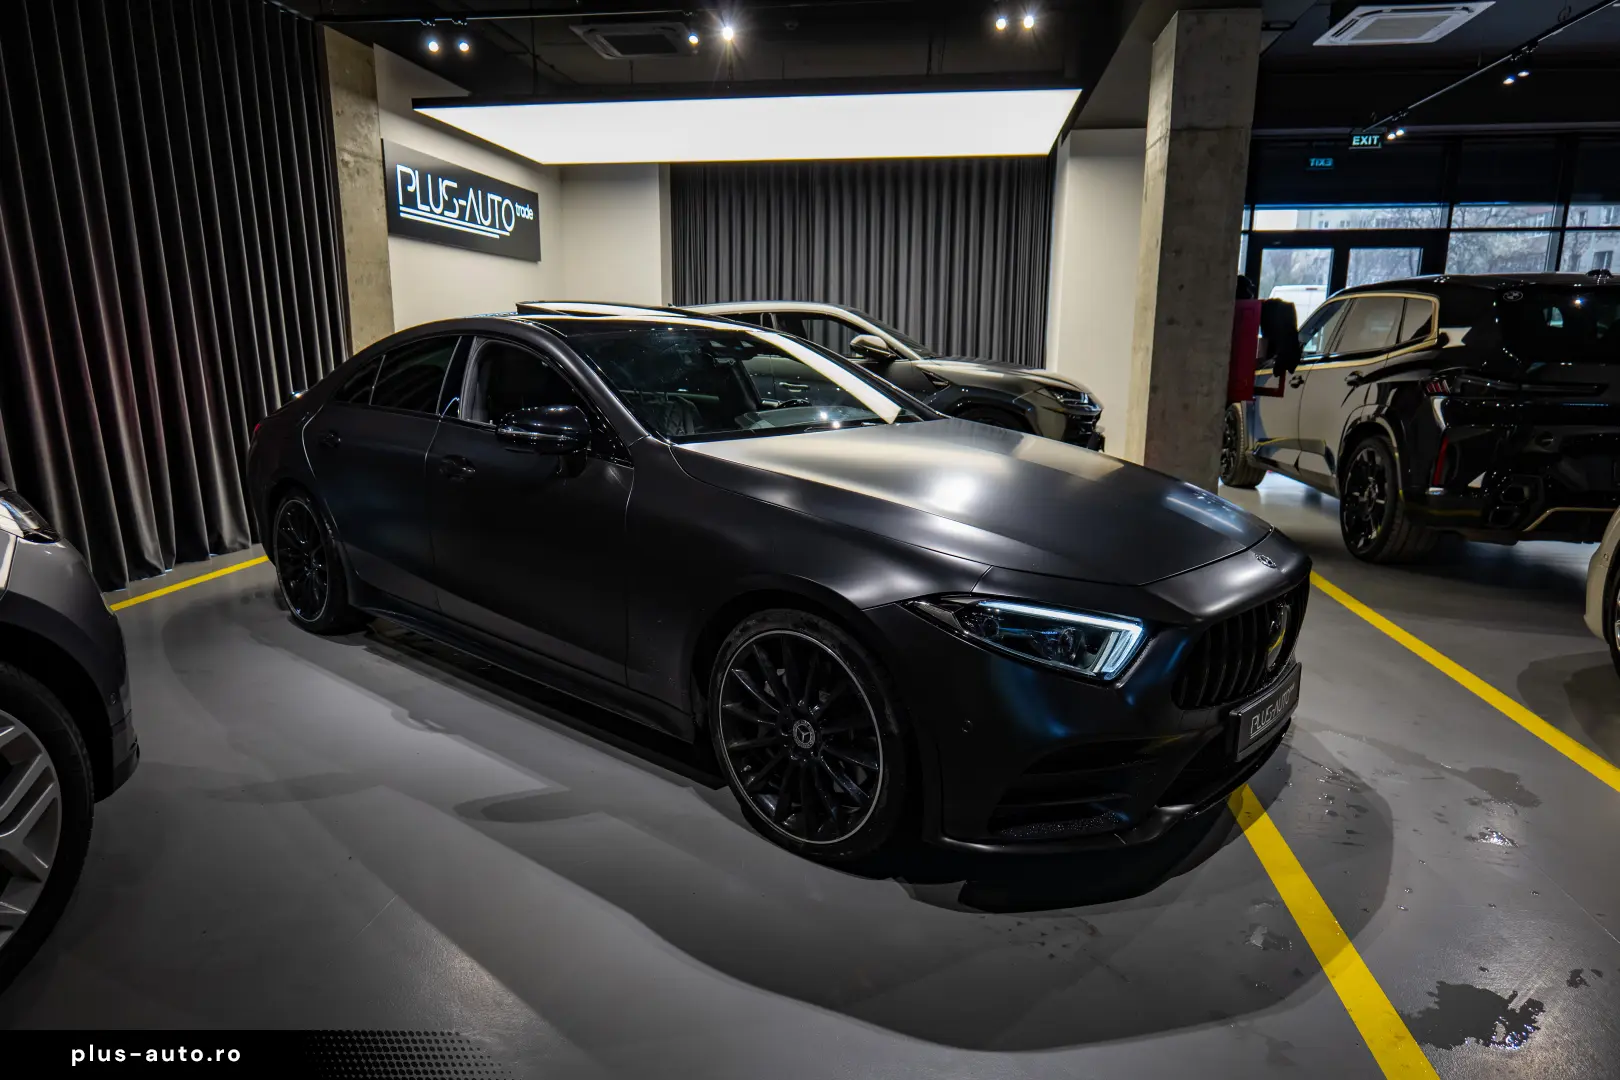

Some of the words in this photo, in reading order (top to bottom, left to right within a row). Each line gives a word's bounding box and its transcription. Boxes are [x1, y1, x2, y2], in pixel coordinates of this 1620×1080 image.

[1352, 136, 1379, 146] EXIT
[397, 164, 515, 232] PLUS-AUTO
[515, 202, 534, 220] trade
[1251, 689, 1290, 734] PLUS-AUTO
